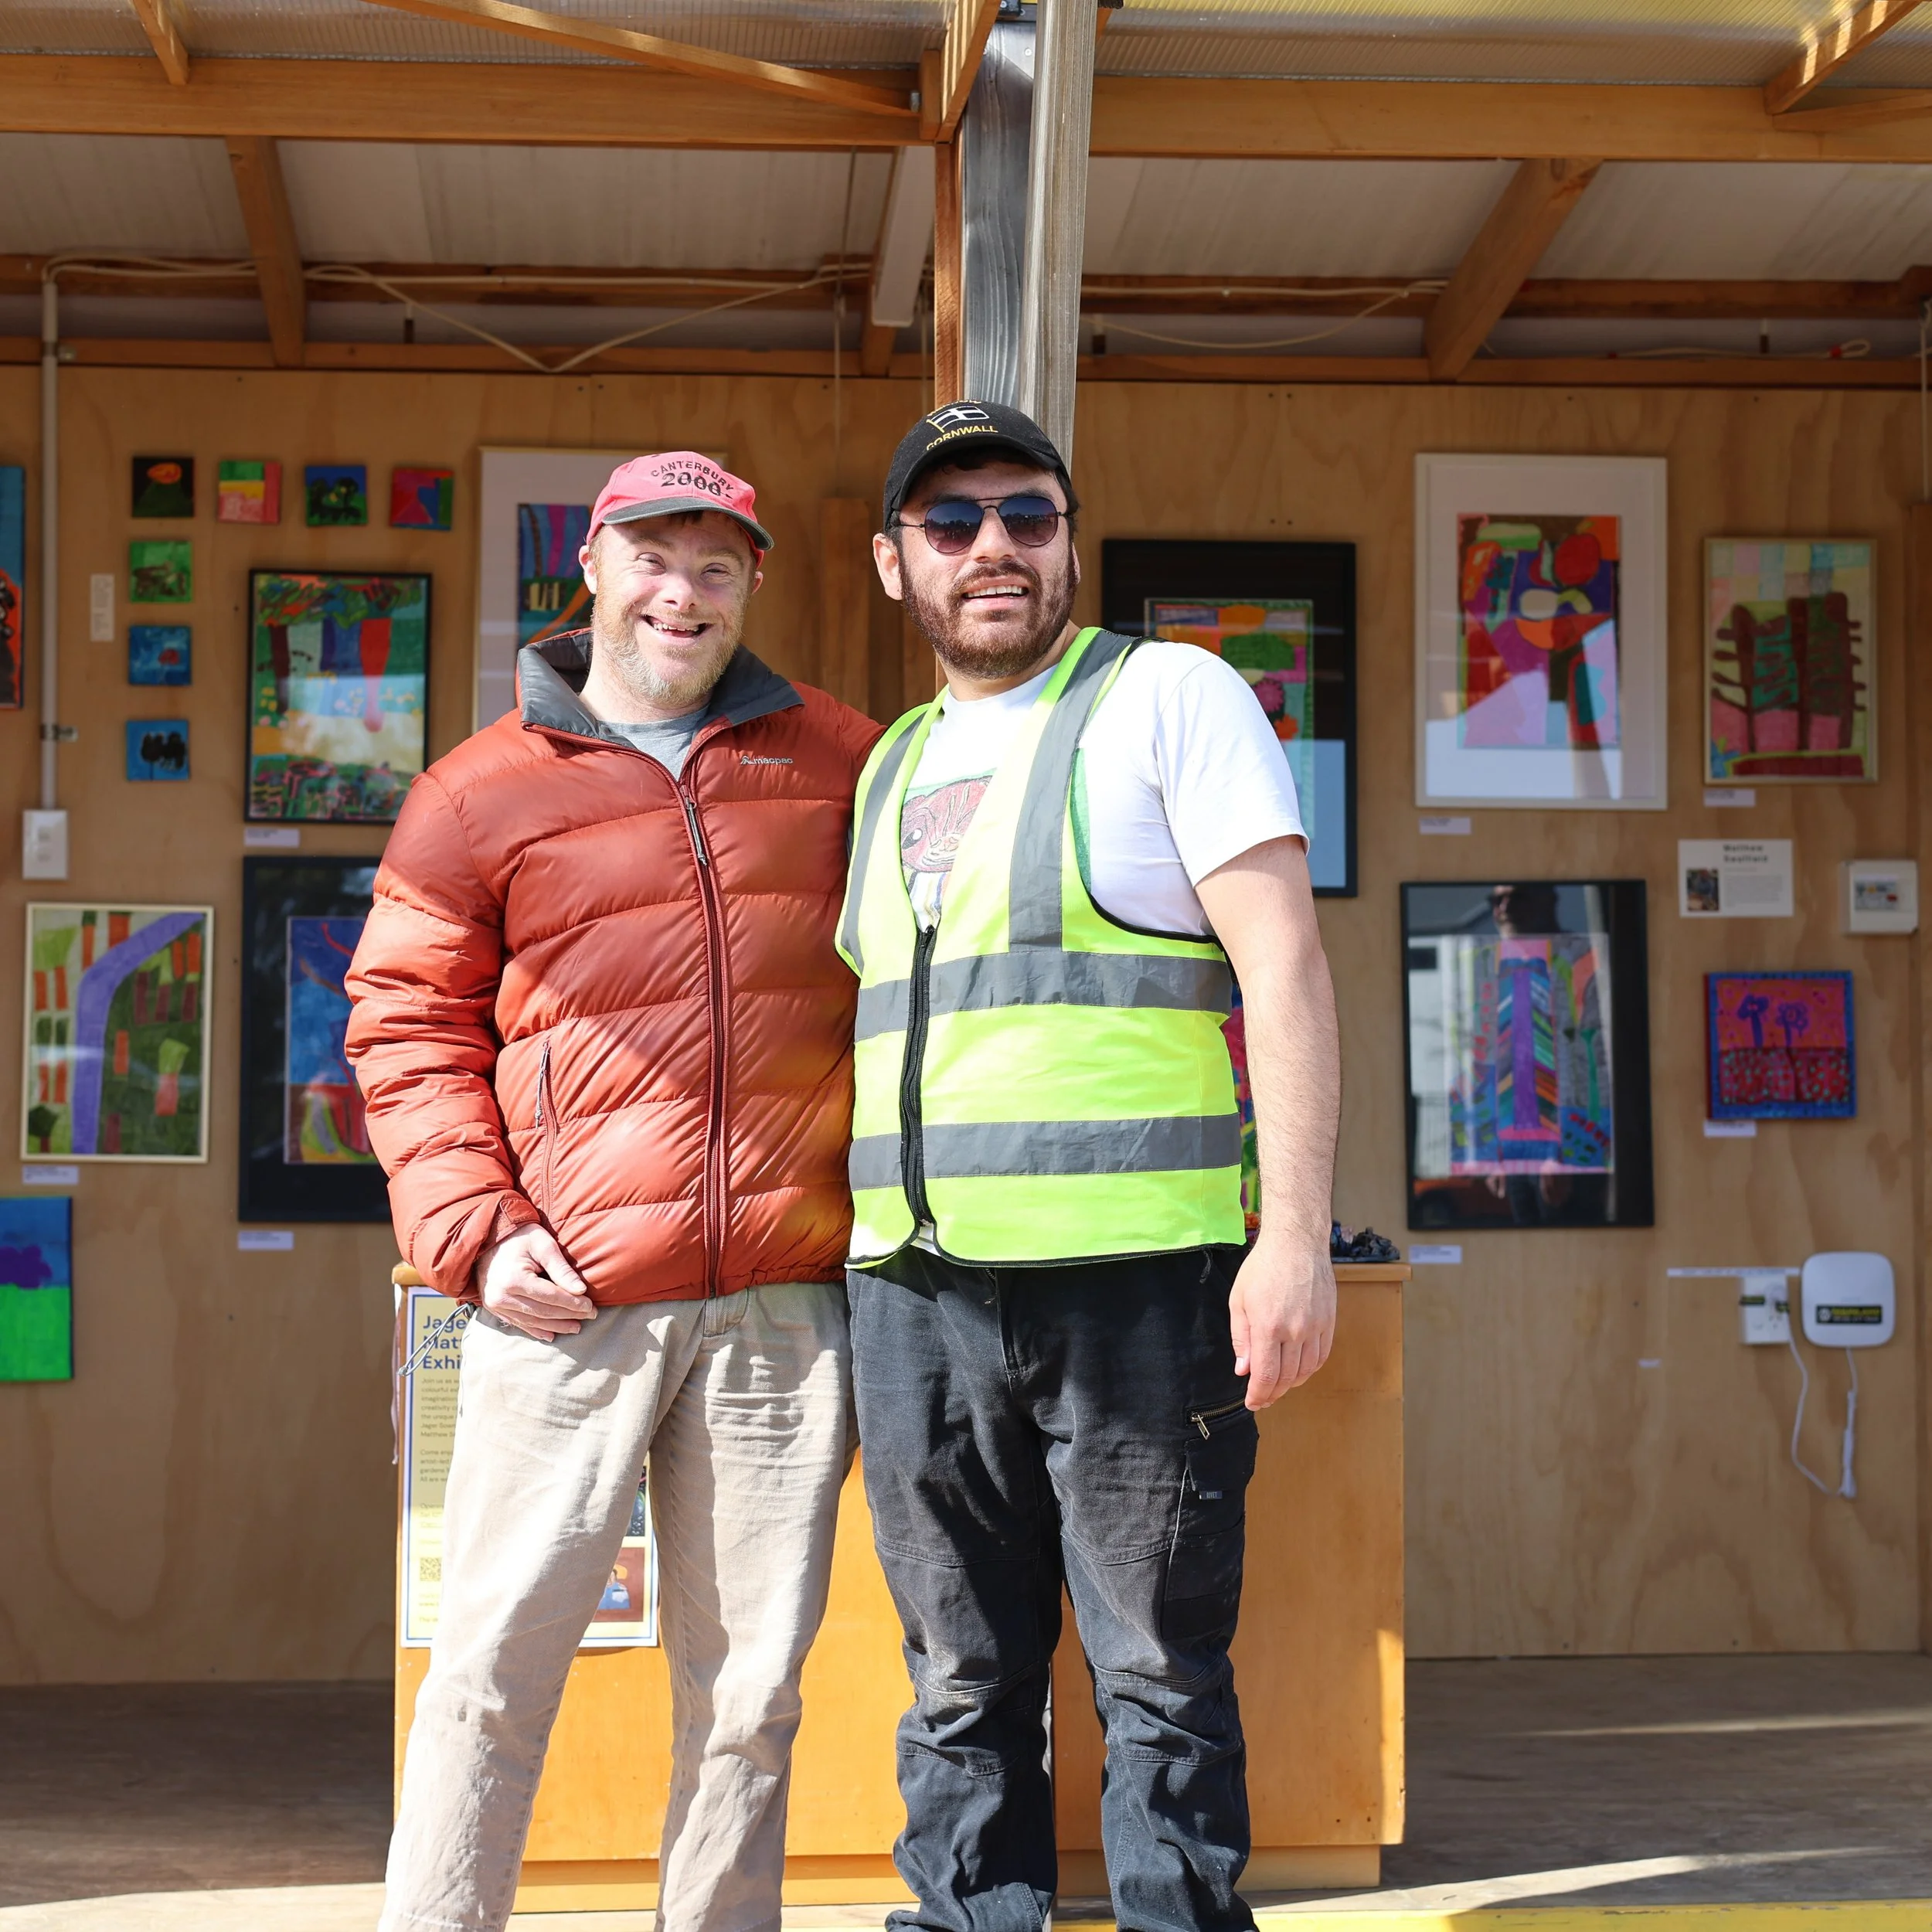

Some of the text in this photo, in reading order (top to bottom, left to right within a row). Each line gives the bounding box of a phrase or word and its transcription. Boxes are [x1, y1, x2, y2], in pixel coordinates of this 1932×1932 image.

[927, 425, 998, 451] CORNWALL
[651, 461, 733, 491] CANTERBURY
[661, 471, 722, 496] 2000
